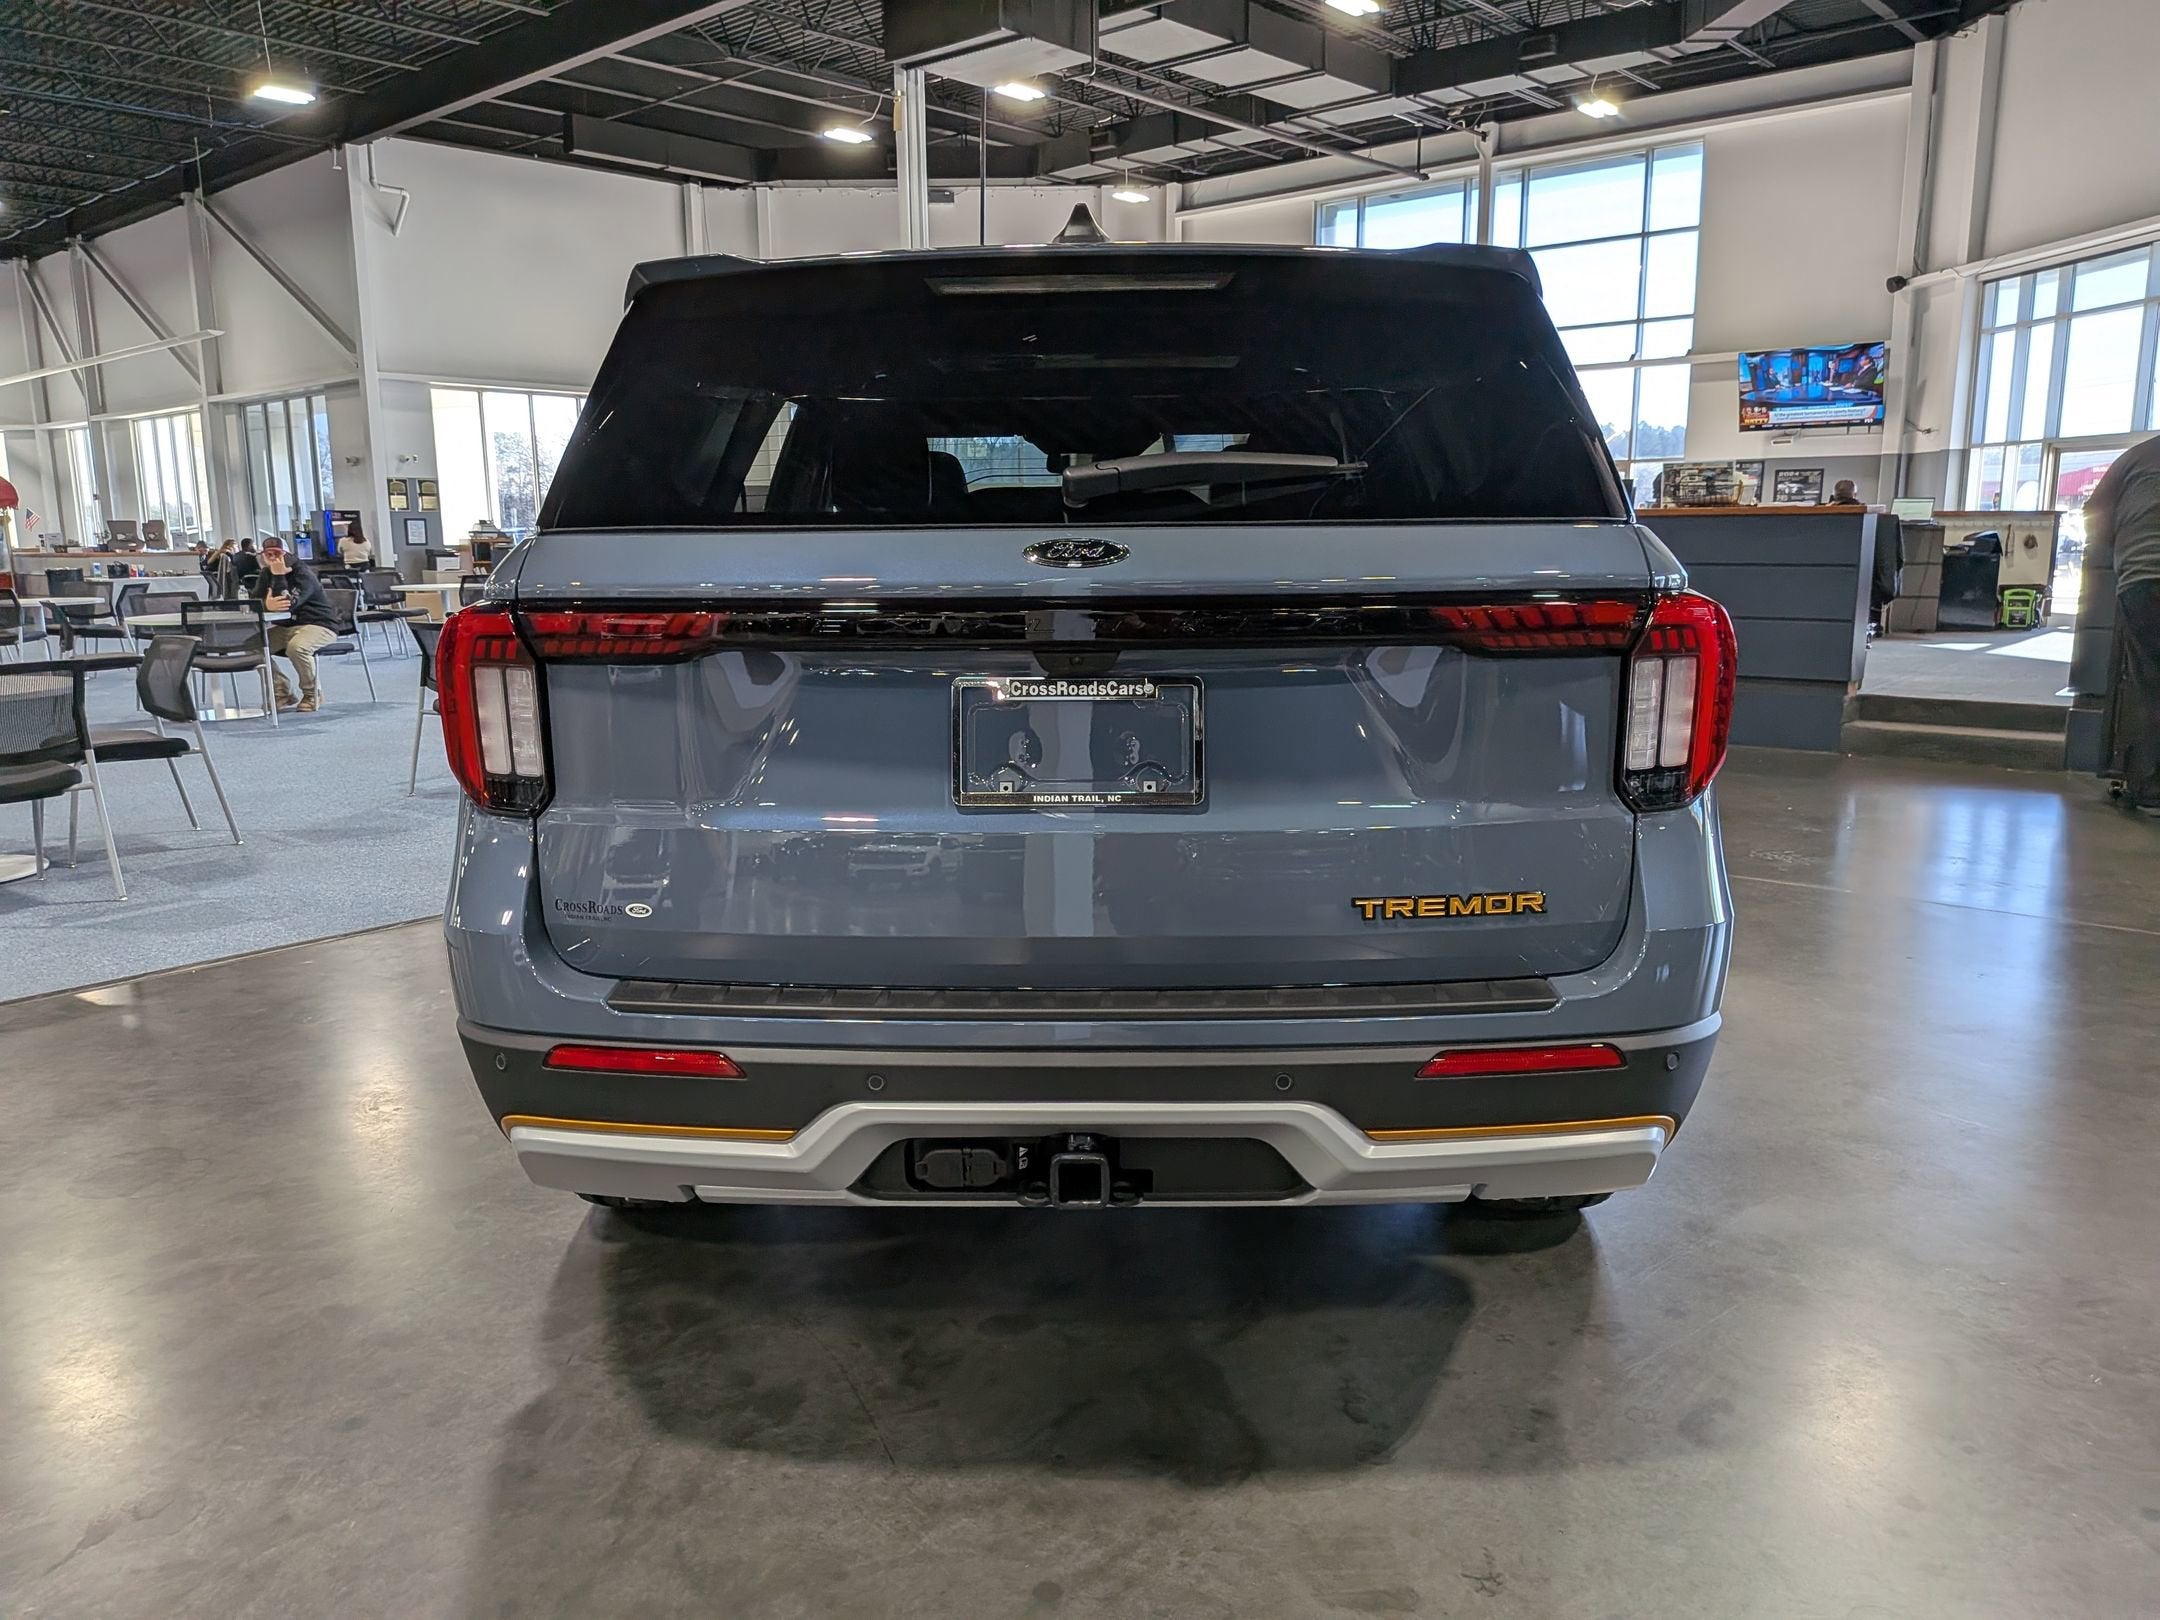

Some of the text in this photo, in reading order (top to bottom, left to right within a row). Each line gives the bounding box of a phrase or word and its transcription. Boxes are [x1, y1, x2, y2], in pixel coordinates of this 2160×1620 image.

[1010, 680, 1144, 696] CrossRoadsCars
[1033, 794, 1122, 804] INDIAN TRAIL, NC
[1352, 890, 1548, 920] TREMOR
